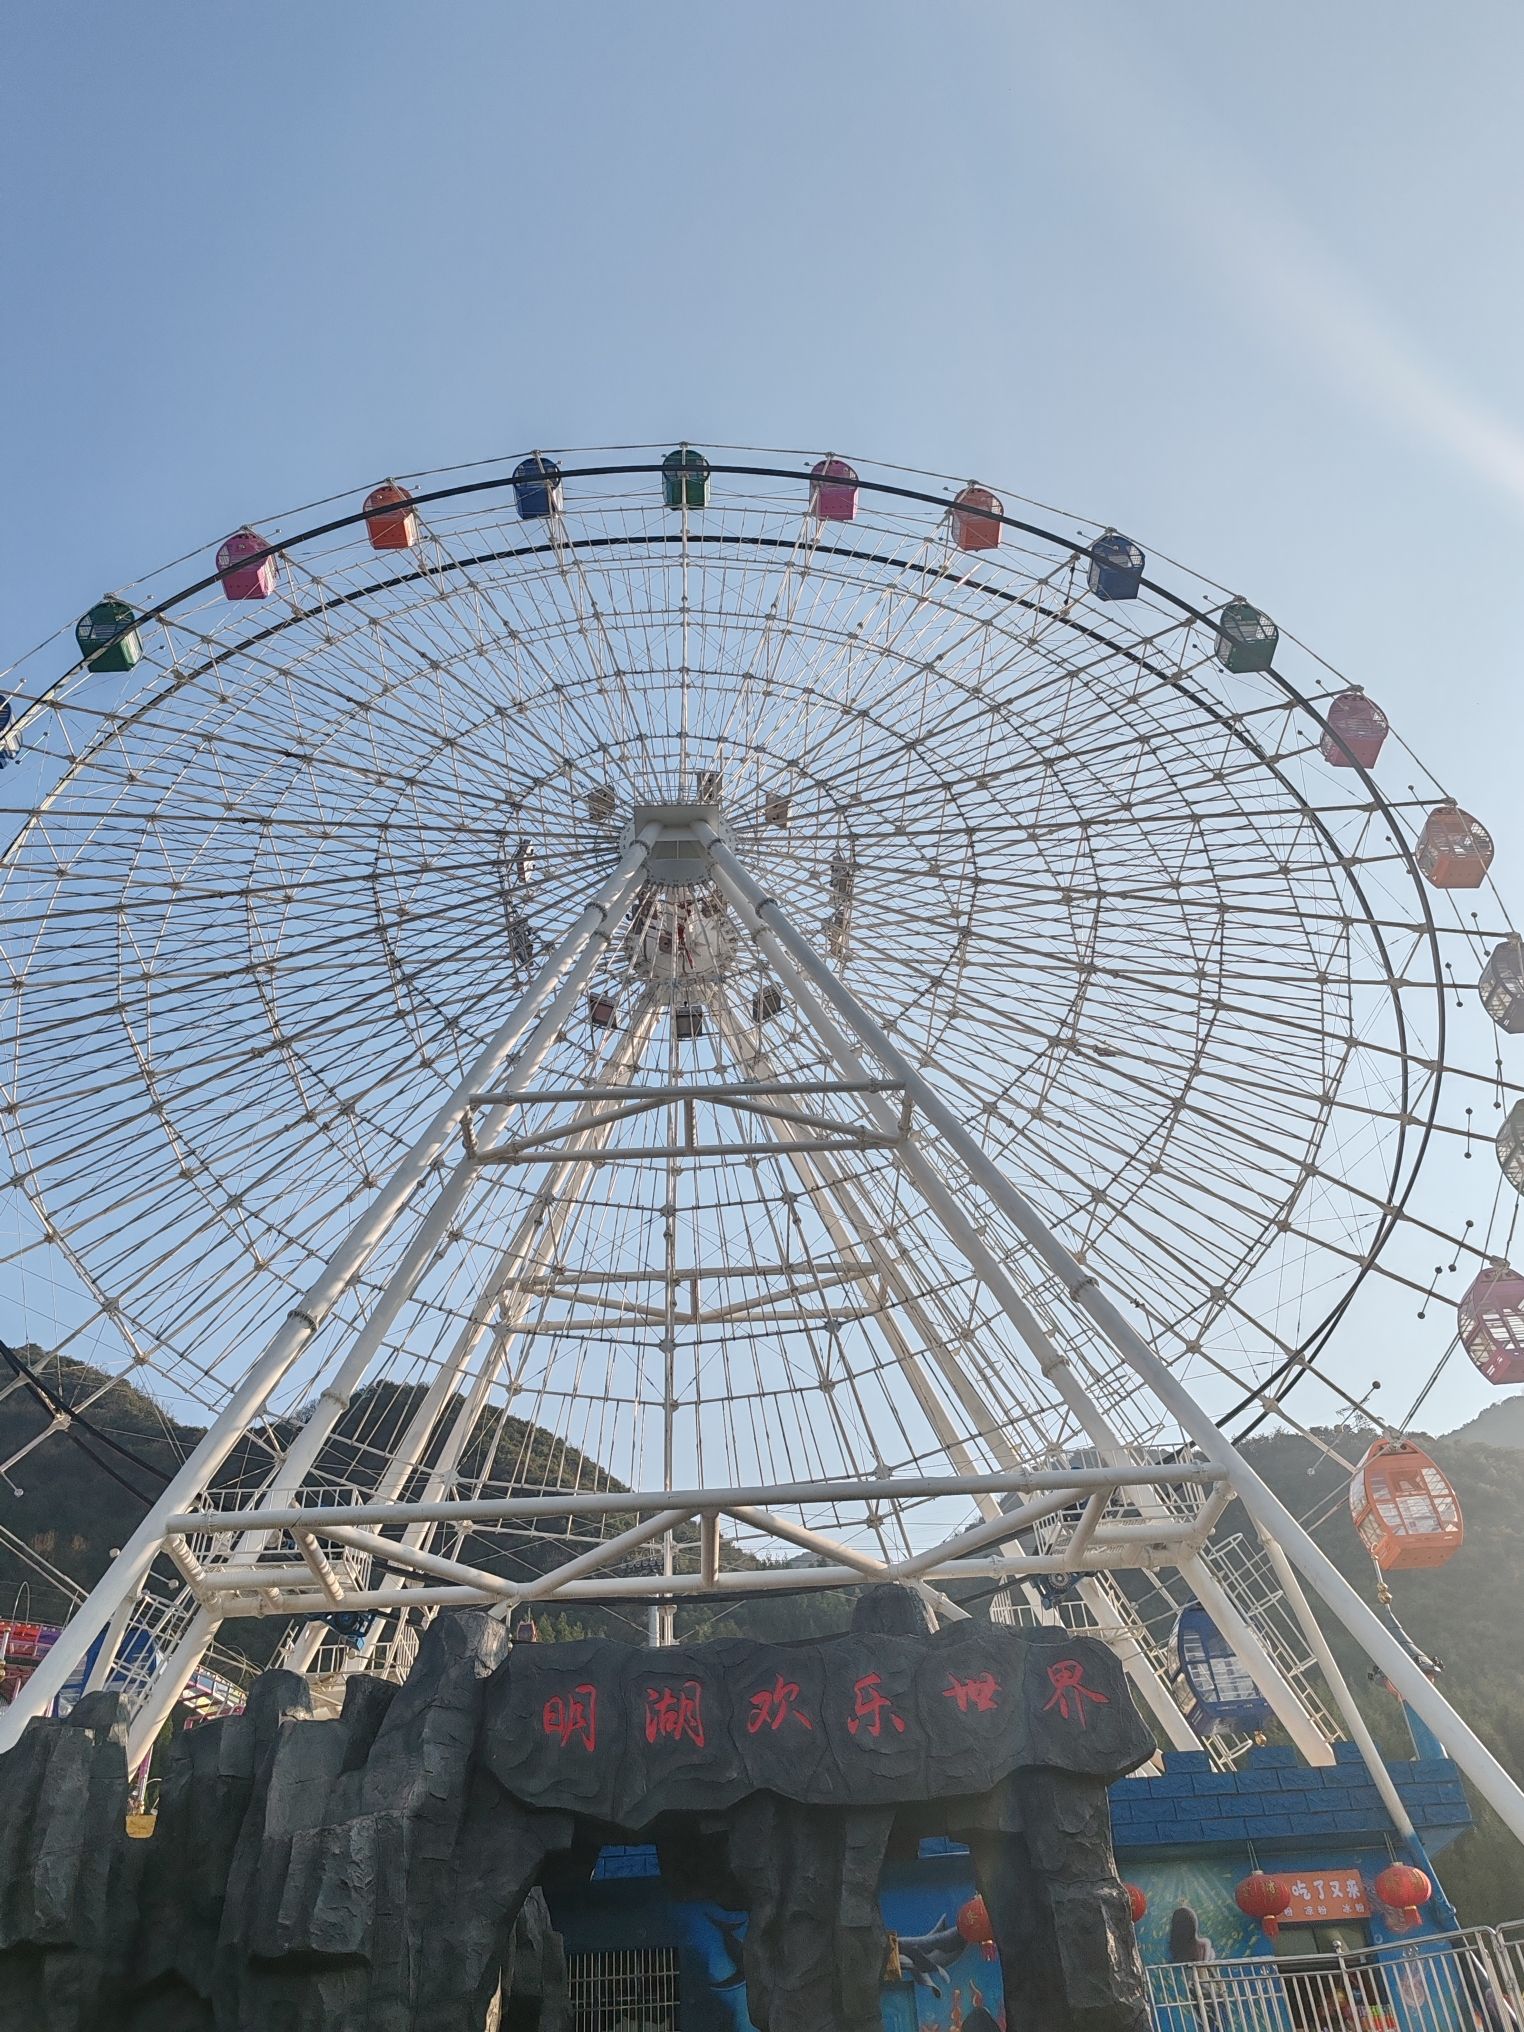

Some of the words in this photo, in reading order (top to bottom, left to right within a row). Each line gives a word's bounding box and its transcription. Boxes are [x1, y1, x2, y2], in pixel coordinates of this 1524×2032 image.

[543, 1659, 1110, 1752] 明湖欢乐世界
[1291, 1879, 1360, 1900] 吃了又来
